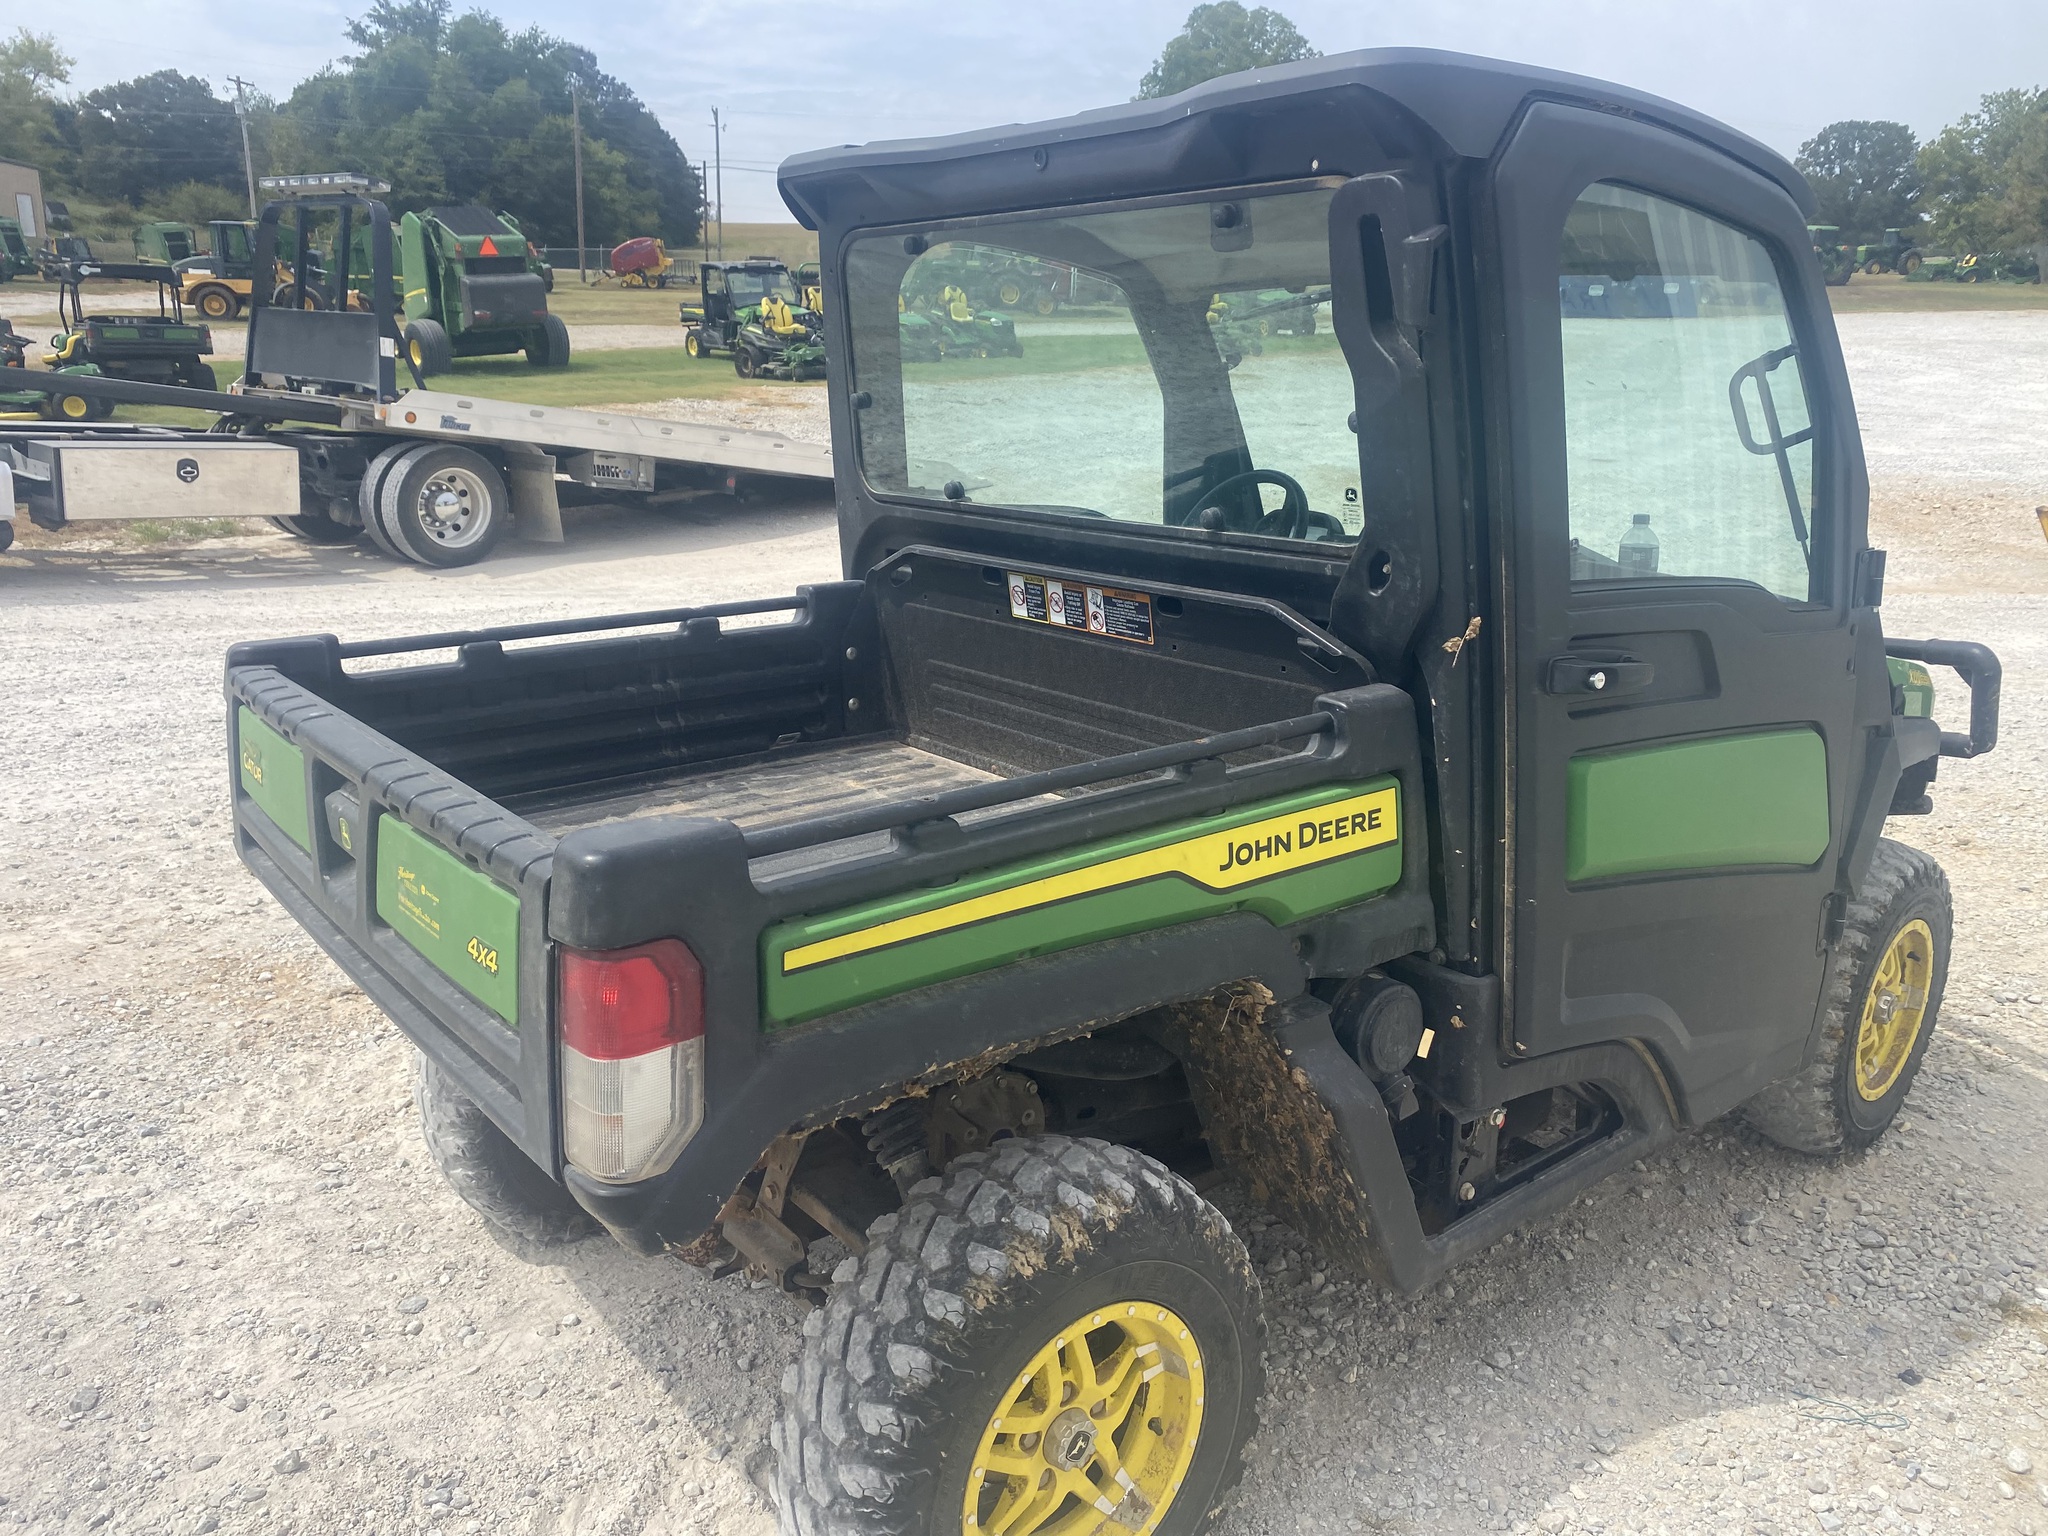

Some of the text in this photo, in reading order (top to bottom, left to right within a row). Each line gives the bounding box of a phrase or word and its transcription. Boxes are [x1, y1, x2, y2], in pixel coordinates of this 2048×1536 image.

[243, 752, 262, 784] GATOR
[1220, 808, 1381, 871] JOHN DEERE
